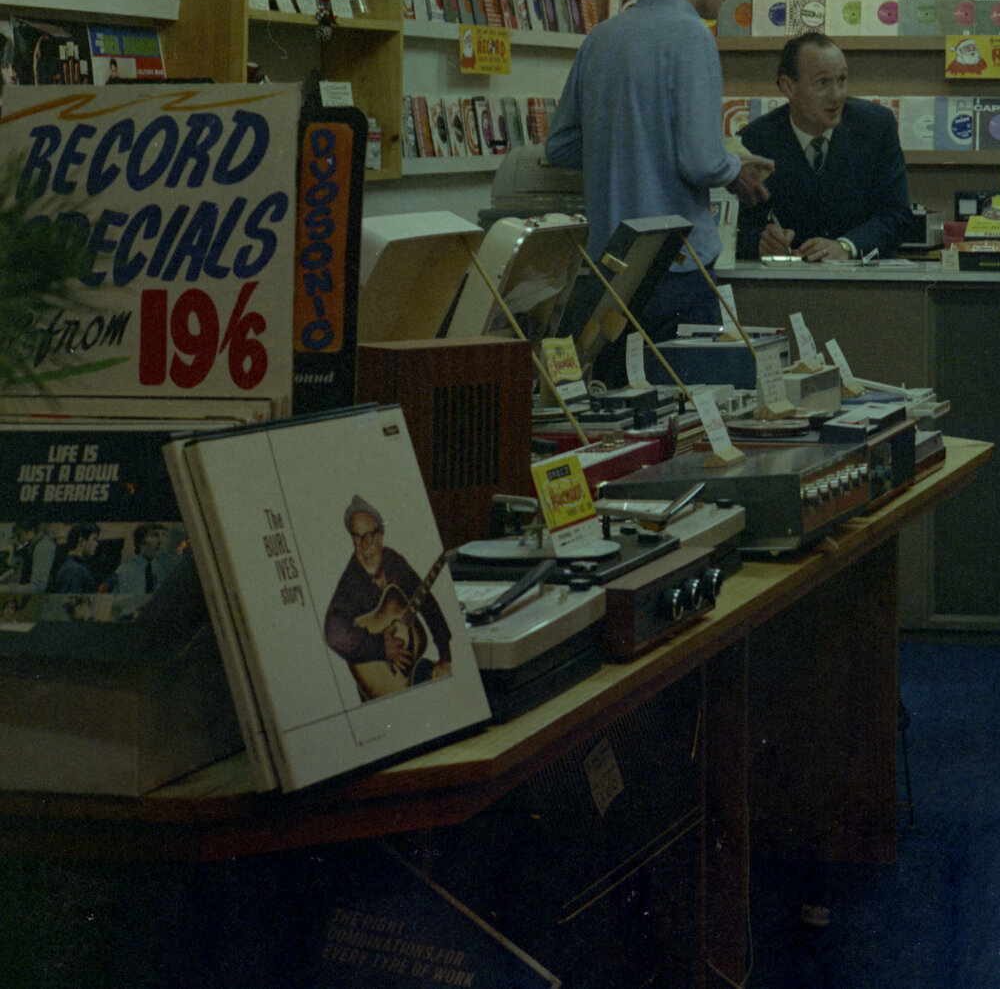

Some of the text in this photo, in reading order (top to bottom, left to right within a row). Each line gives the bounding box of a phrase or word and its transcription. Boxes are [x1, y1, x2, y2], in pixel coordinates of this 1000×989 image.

[14, 109, 271, 202] RECORD
[33, 281, 269, 391] from 19/6
[48, 444, 99, 462] LIFE IS
[17, 463, 120, 483] JUST A BOWL
[19, 483, 111, 502] OF BERRIES
[264, 508, 284, 531] The
[262, 531, 292, 558] BURL
[274, 555, 299, 583] IVES
